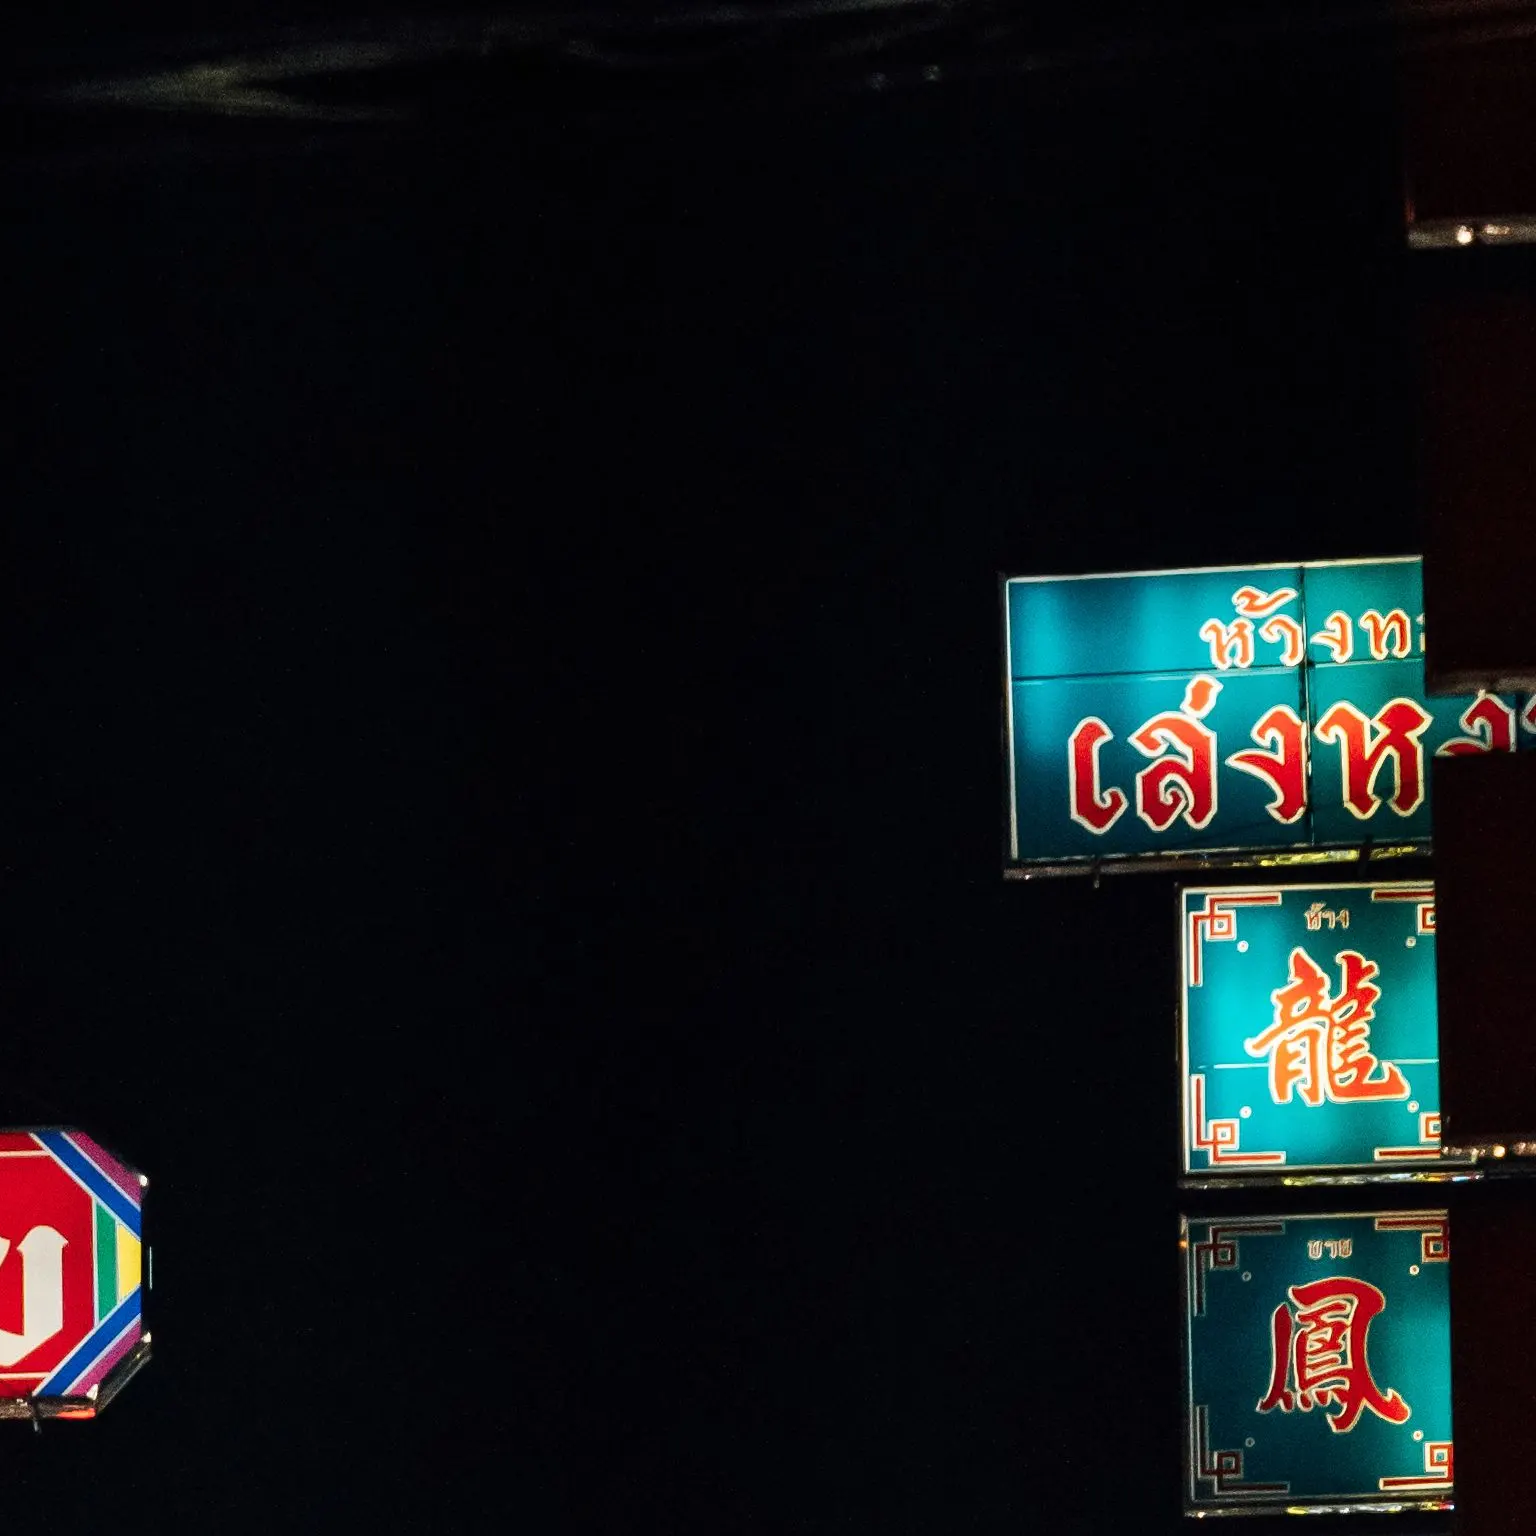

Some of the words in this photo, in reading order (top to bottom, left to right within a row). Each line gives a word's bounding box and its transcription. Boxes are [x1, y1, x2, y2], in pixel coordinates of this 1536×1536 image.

[1200, 586, 1426, 669] ห้างท
[1068, 675, 1536, 833] เล่งหง
[1304, 902, 1350, 930] ห้าง
